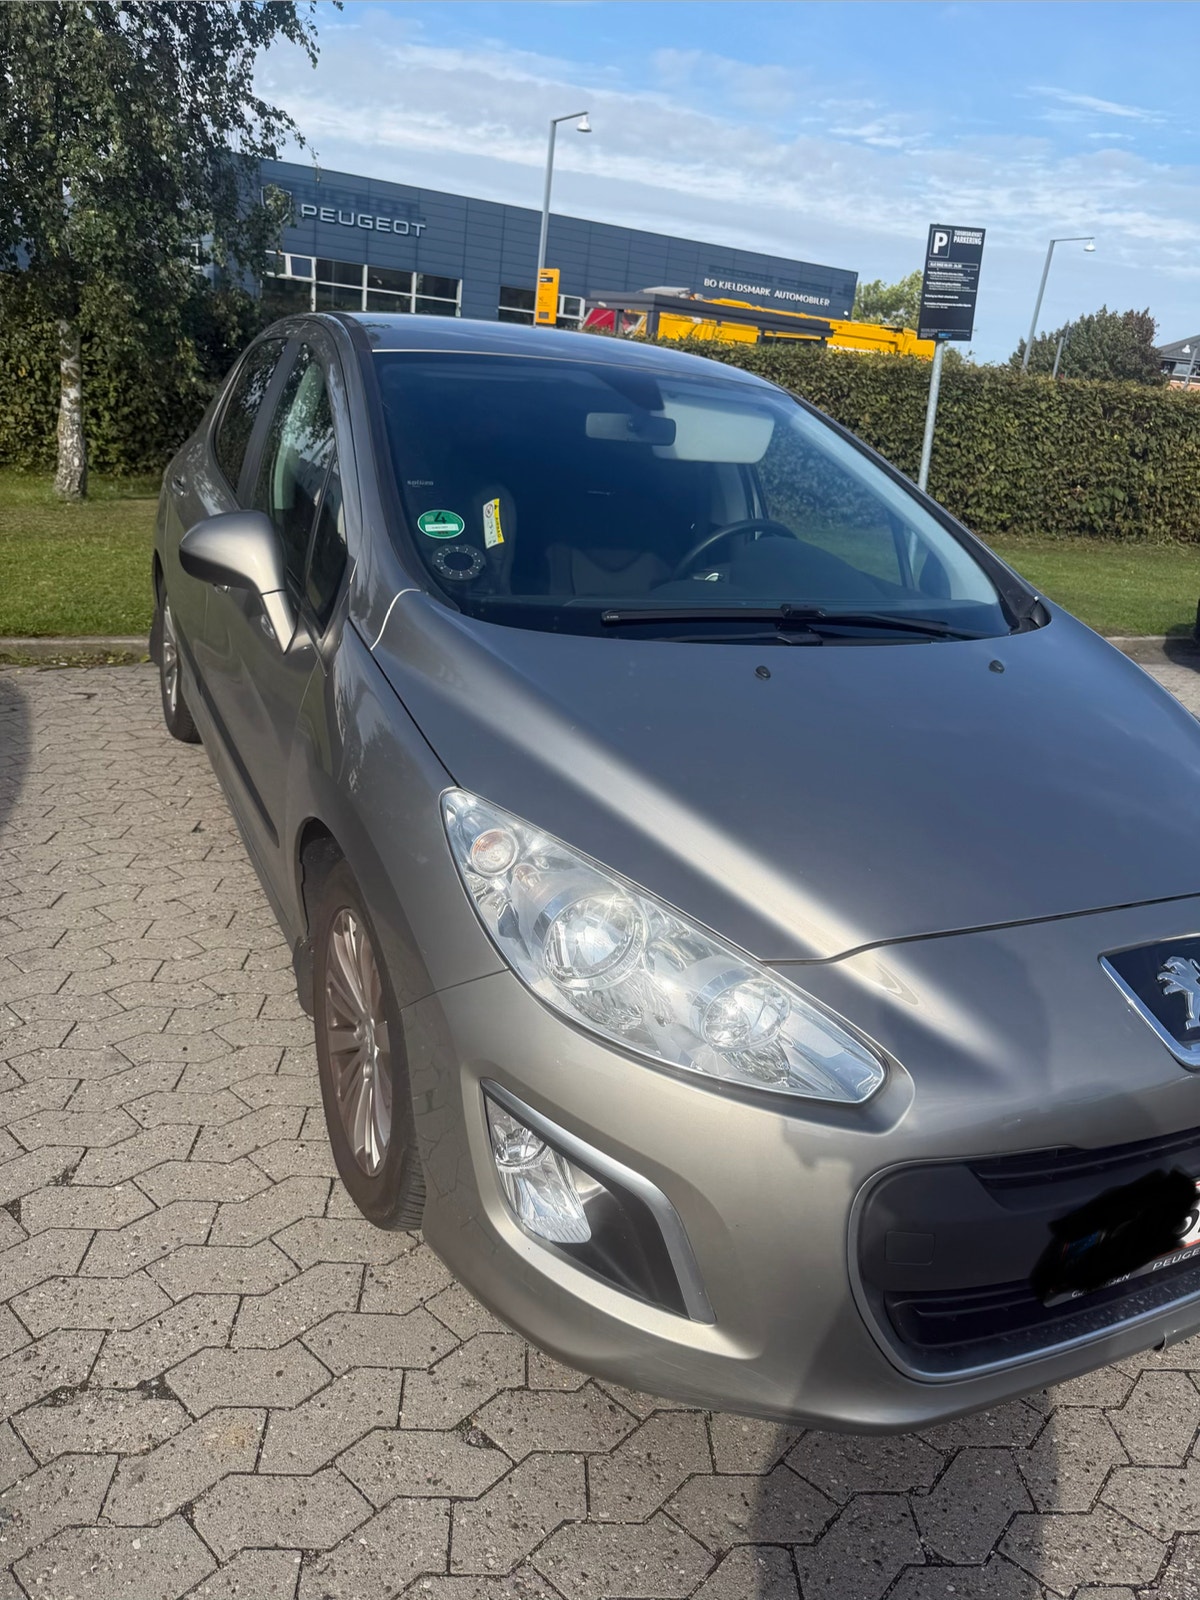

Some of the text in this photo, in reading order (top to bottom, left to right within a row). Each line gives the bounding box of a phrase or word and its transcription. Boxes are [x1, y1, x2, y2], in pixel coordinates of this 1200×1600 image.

[301, 203, 426, 237] PEUGEOT
[933, 232, 948, 254] P
[953, 236, 982, 245] PARKERING
[704, 278, 830, 306] BO KJELDSMARK AUTOMOBILER
[434, 511, 447, 523] 4
